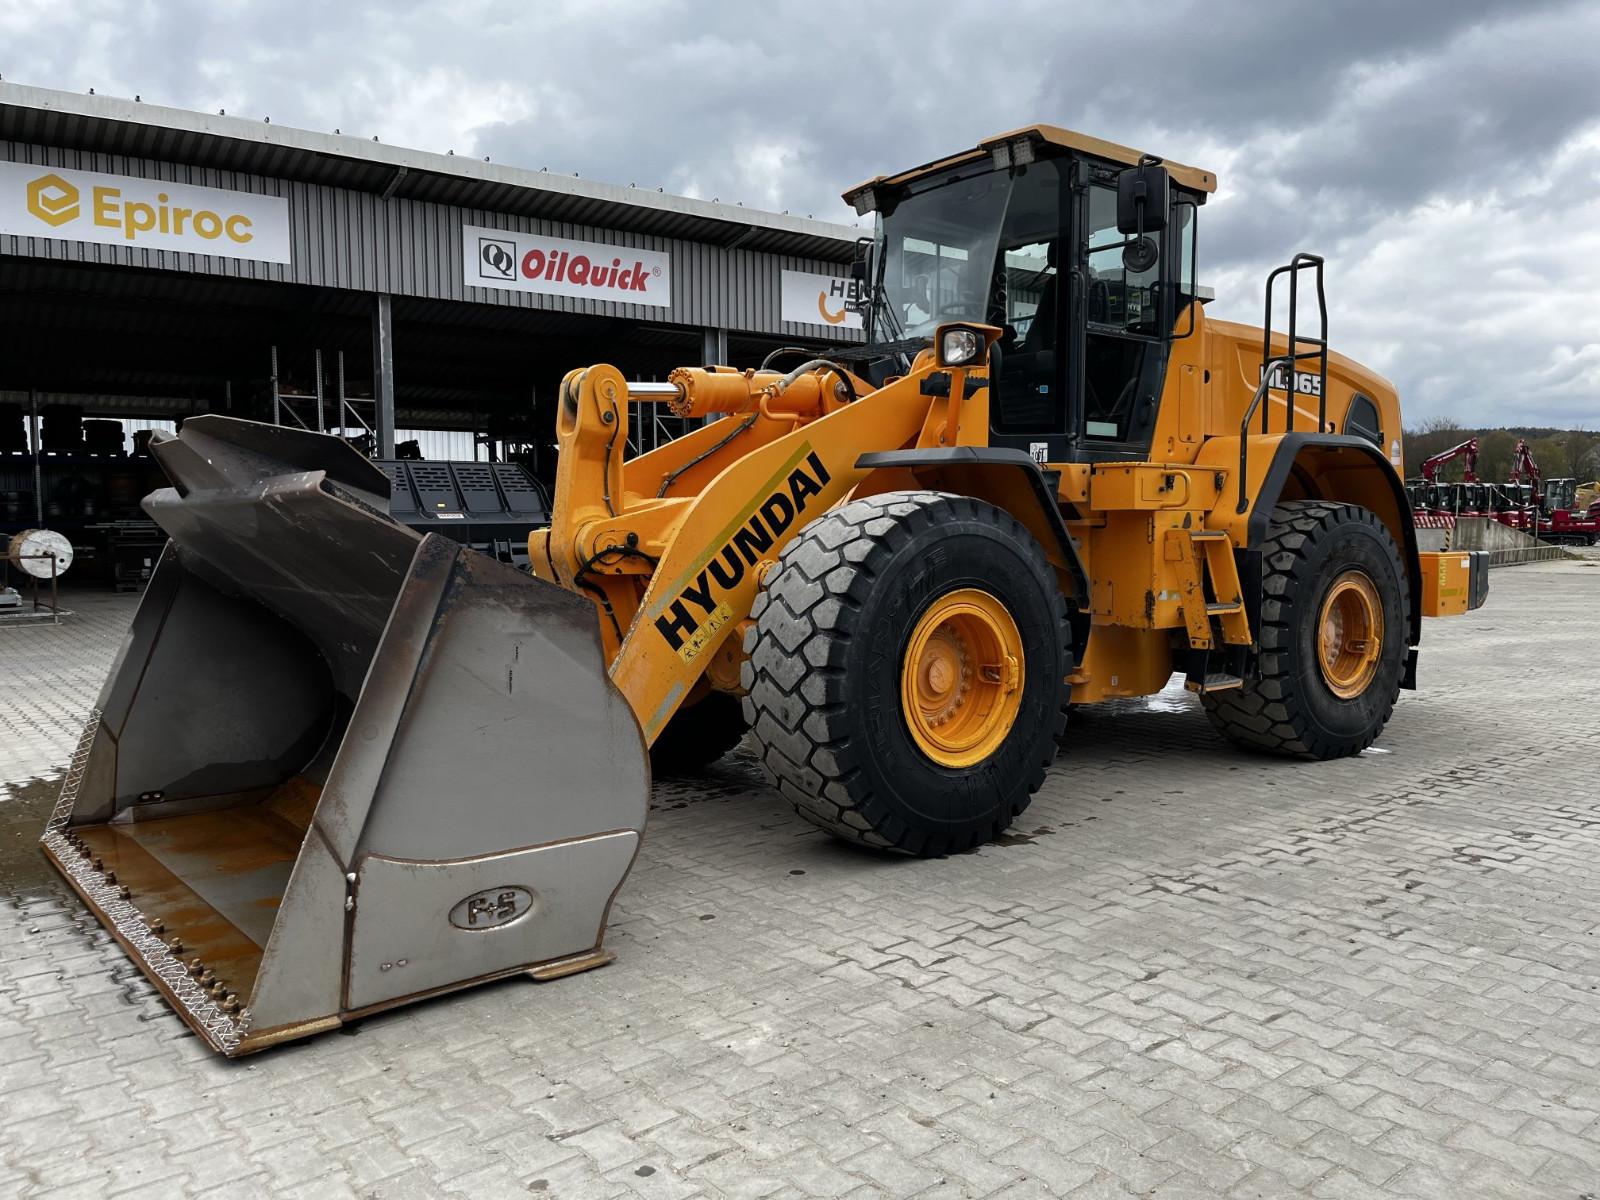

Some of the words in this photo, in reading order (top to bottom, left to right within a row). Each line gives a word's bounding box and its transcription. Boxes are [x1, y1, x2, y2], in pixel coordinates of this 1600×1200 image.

[93, 185, 254, 243] Epiroc
[521, 249, 650, 292] OilQuick
[654, 450, 831, 652] HYUNDAI
